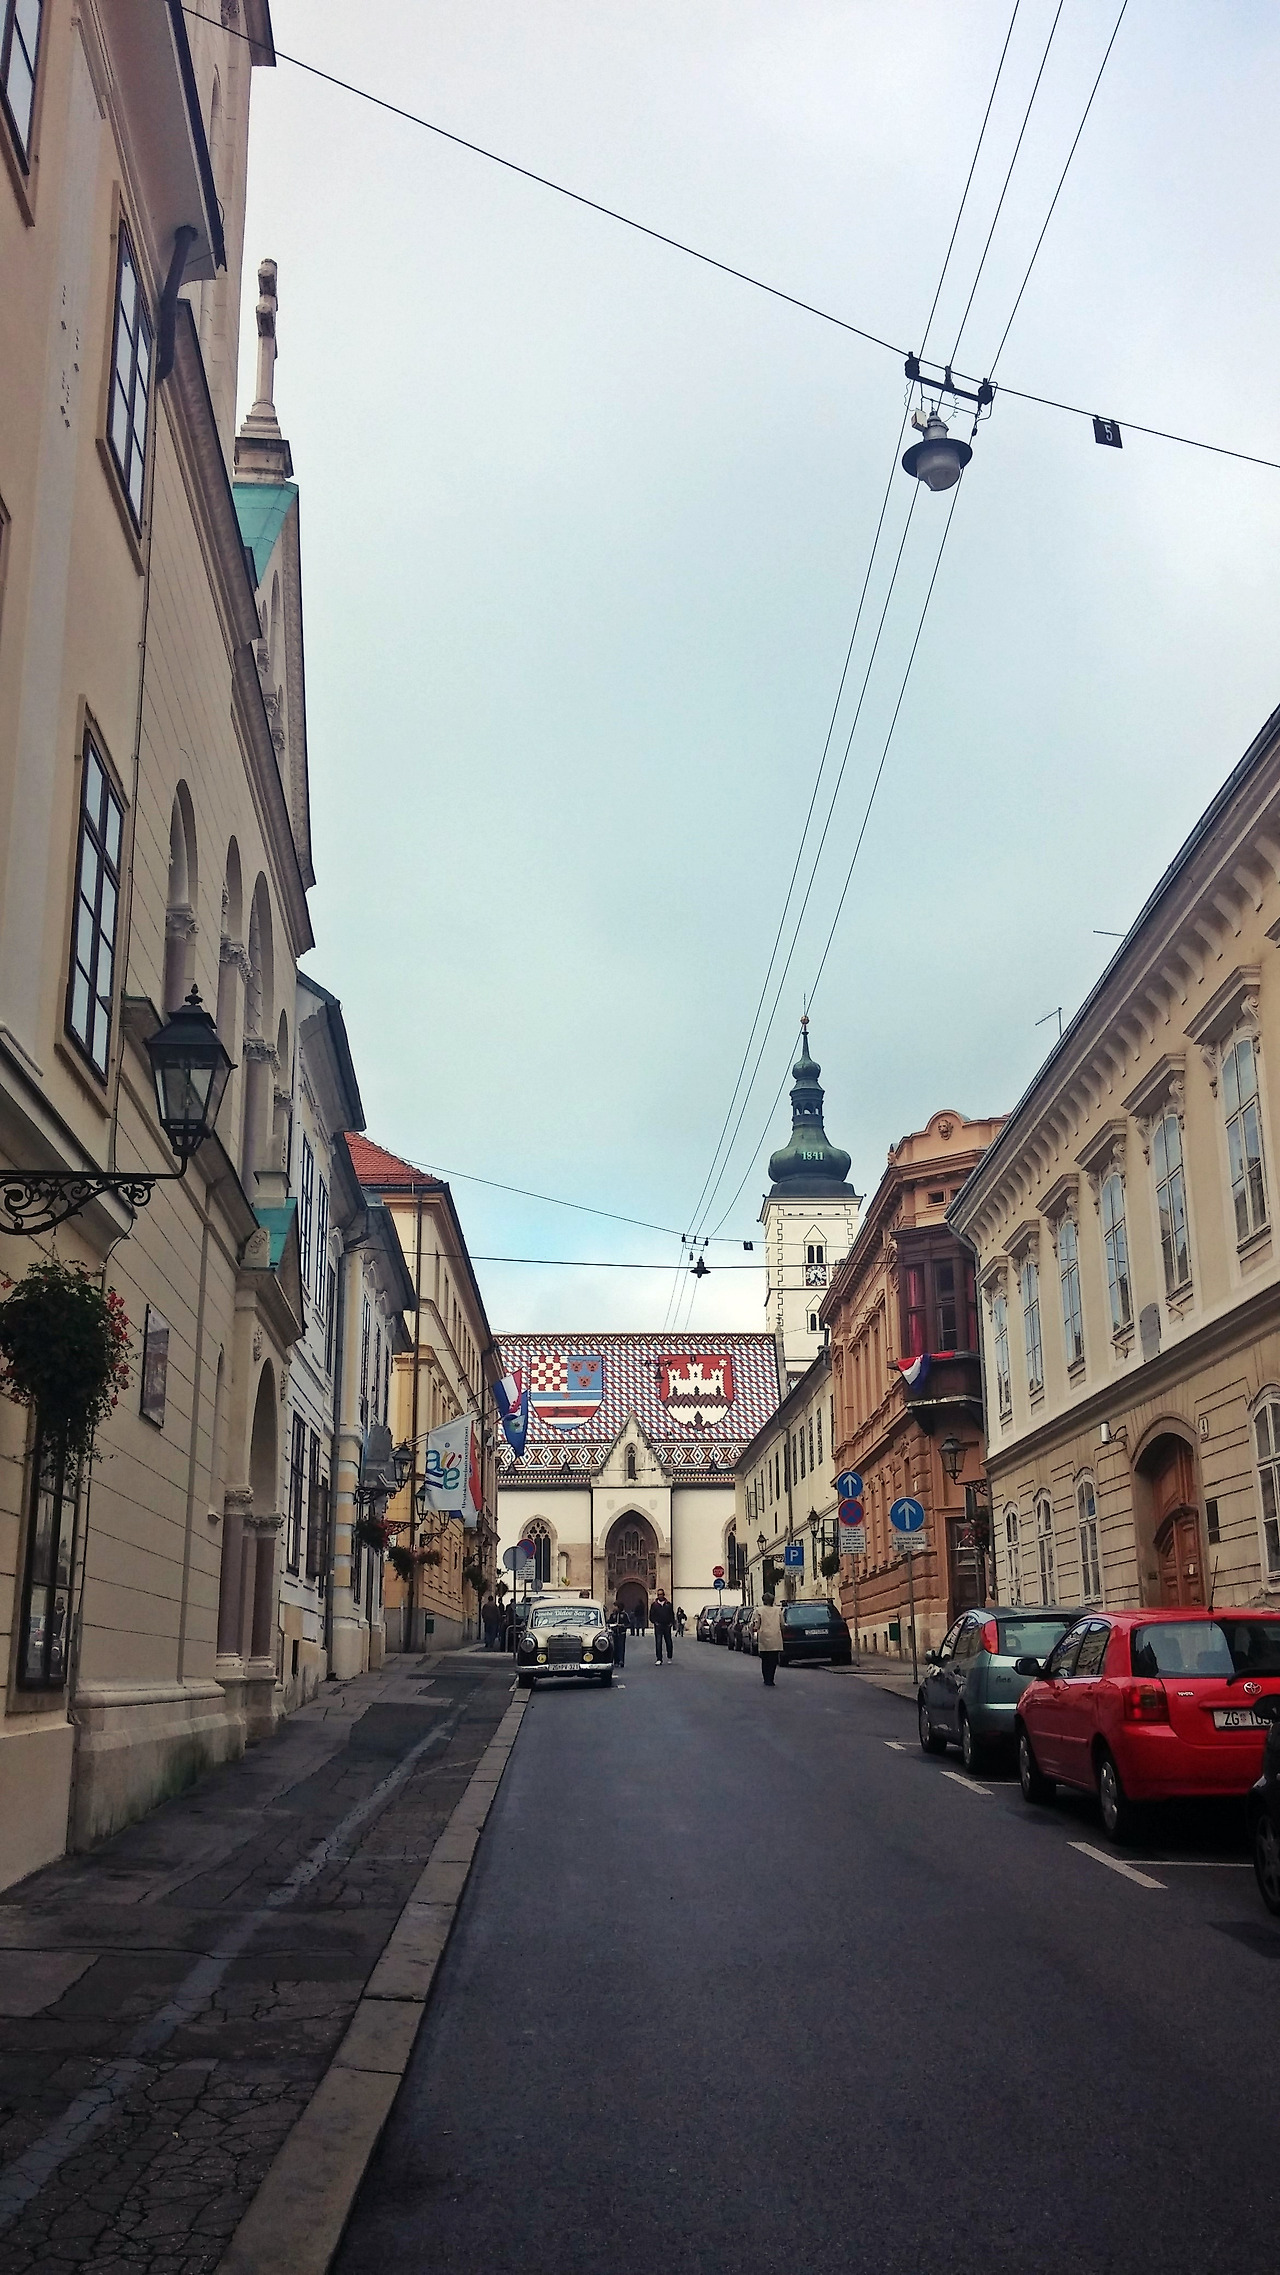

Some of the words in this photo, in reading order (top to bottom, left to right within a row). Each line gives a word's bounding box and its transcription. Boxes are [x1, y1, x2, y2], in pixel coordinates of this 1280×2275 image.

[1104, 424, 1113, 442] 5
[801, 1151, 824, 1161] 1841
[790, 1549, 799, 1562] P
[1223, 1711, 1239, 1726] ZG
